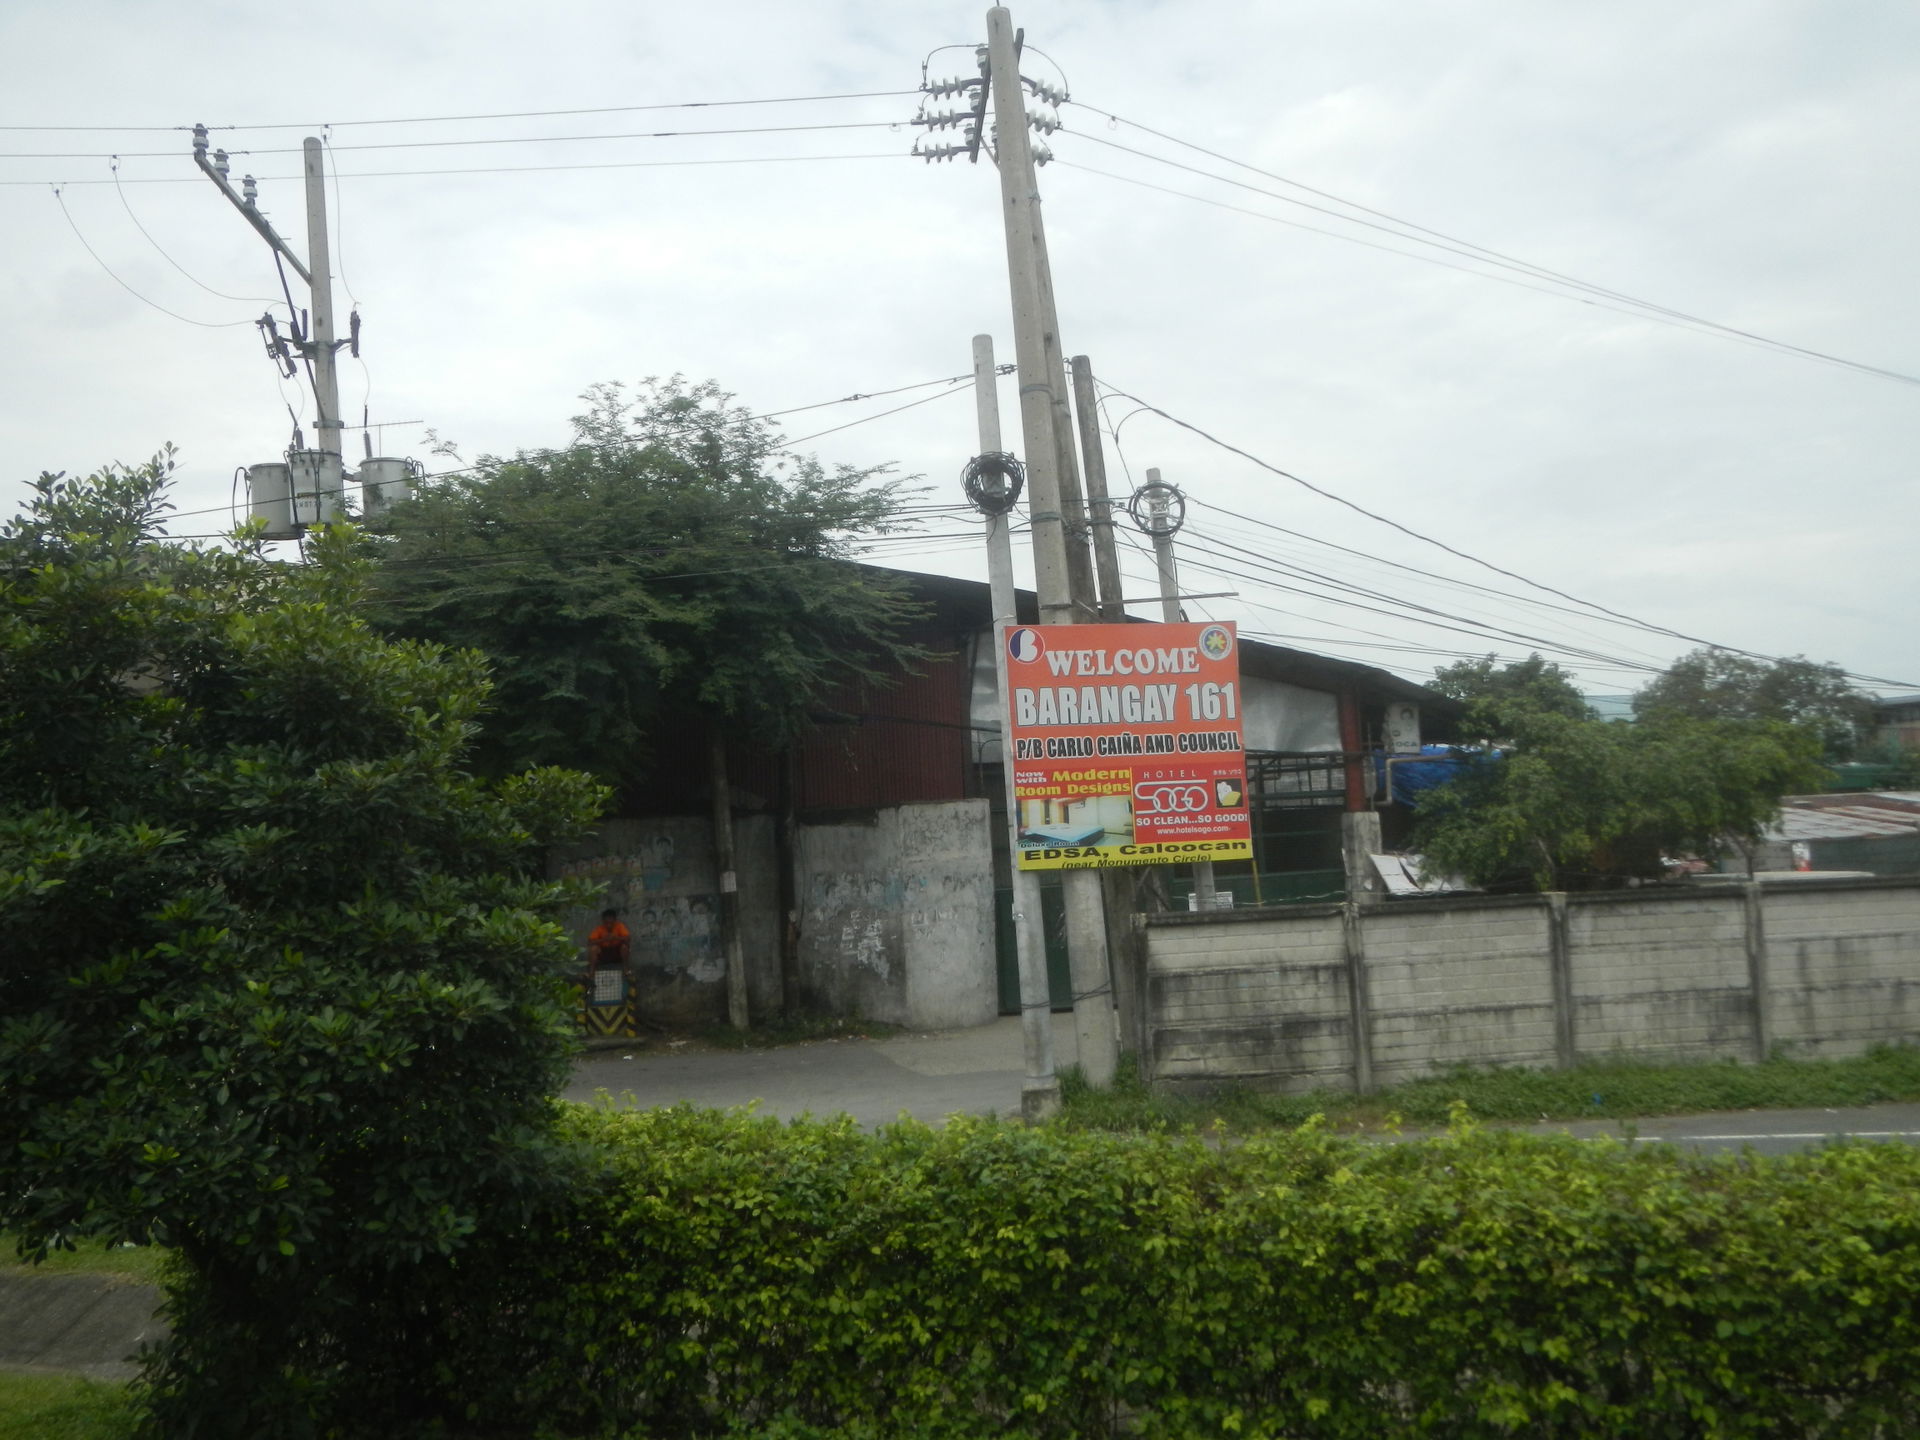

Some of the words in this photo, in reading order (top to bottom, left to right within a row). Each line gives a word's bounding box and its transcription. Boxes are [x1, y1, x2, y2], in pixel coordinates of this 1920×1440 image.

[1045, 647, 1200, 677] WELCOME
[1015, 683, 1177, 727] BARANGAY
[1185, 682, 1237, 721] 161
[1016, 737, 1043, 760] P/B
[1046, 736, 1095, 759] CARLO
[1097, 732, 1143, 756] CAIÑA
[1145, 734, 1175, 754] AND
[1178, 731, 1241, 752] COUNCIL
[1052, 769, 1130, 782] Modern
[1143, 769, 1197, 778] HOTEL
[1015, 785, 1061, 797] Room
[1067, 782, 1131, 795] Designs
[1134, 779, 1208, 814] SOGO
[1136, 817, 1151, 826] SO
[1215, 813, 1248, 822] GOOD!
[1024, 847, 1109, 861] EDSA,
[1120, 841, 1247, 855] Caloocan
[1061, 861, 1095, 869] (near
[1097, 857, 1169, 868] Monumento
[1172, 854, 1212, 863] Circle)
